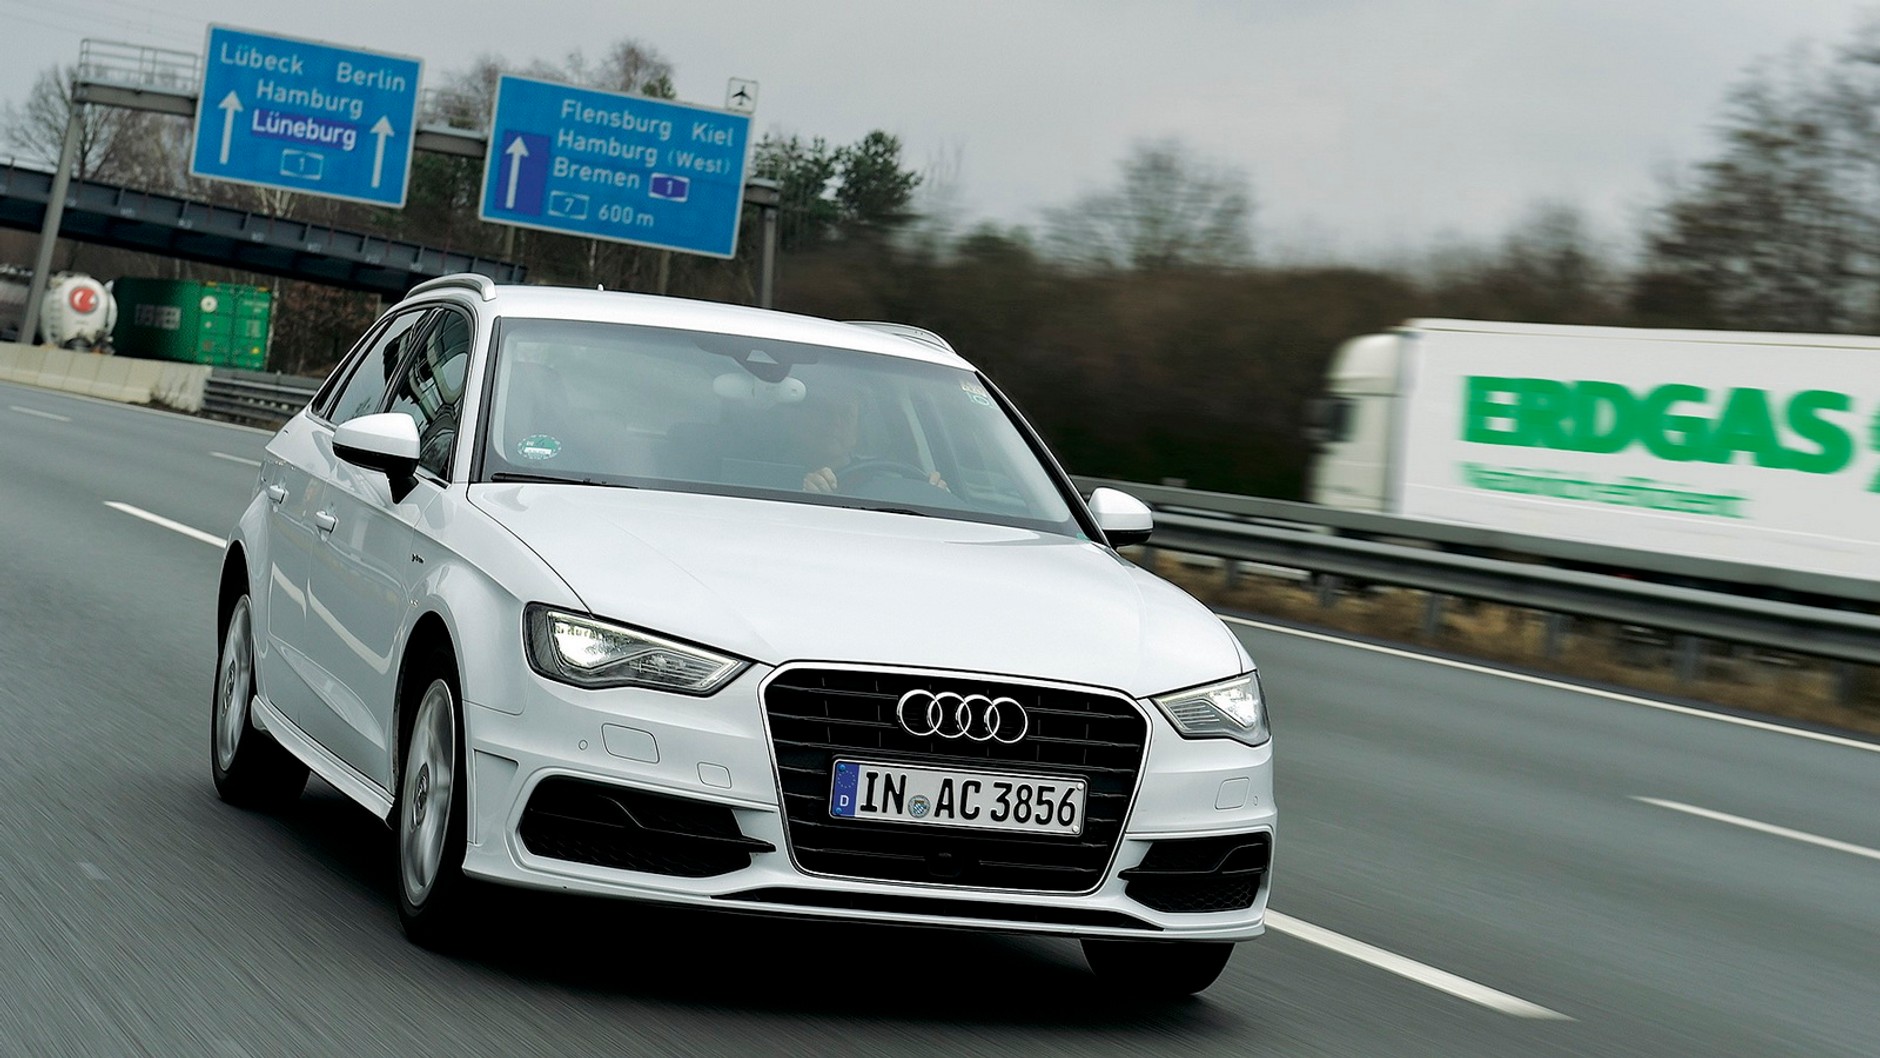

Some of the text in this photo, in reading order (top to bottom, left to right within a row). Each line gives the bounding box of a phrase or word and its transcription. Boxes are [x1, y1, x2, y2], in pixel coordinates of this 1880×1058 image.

[220, 42, 406, 92] Lübeck Berlin
[256, 78, 364, 120] Hamburg
[252, 108, 357, 151] Lüneburg
[560, 99, 734, 148] Flensburg Kiel
[557, 129, 731, 175] Hamburg (West)
[552, 157, 641, 190] Bremen
[665, 180, 673, 195] 1
[564, 198, 575, 213] 7
[598, 204, 655, 227] 600 m
[1460, 374, 1856, 474] ERDGAS
[839, 794, 849, 807] D
[860, 771, 907, 815] IN
[934, 777, 982, 820] AC
[990, 781, 1076, 827] 3856
